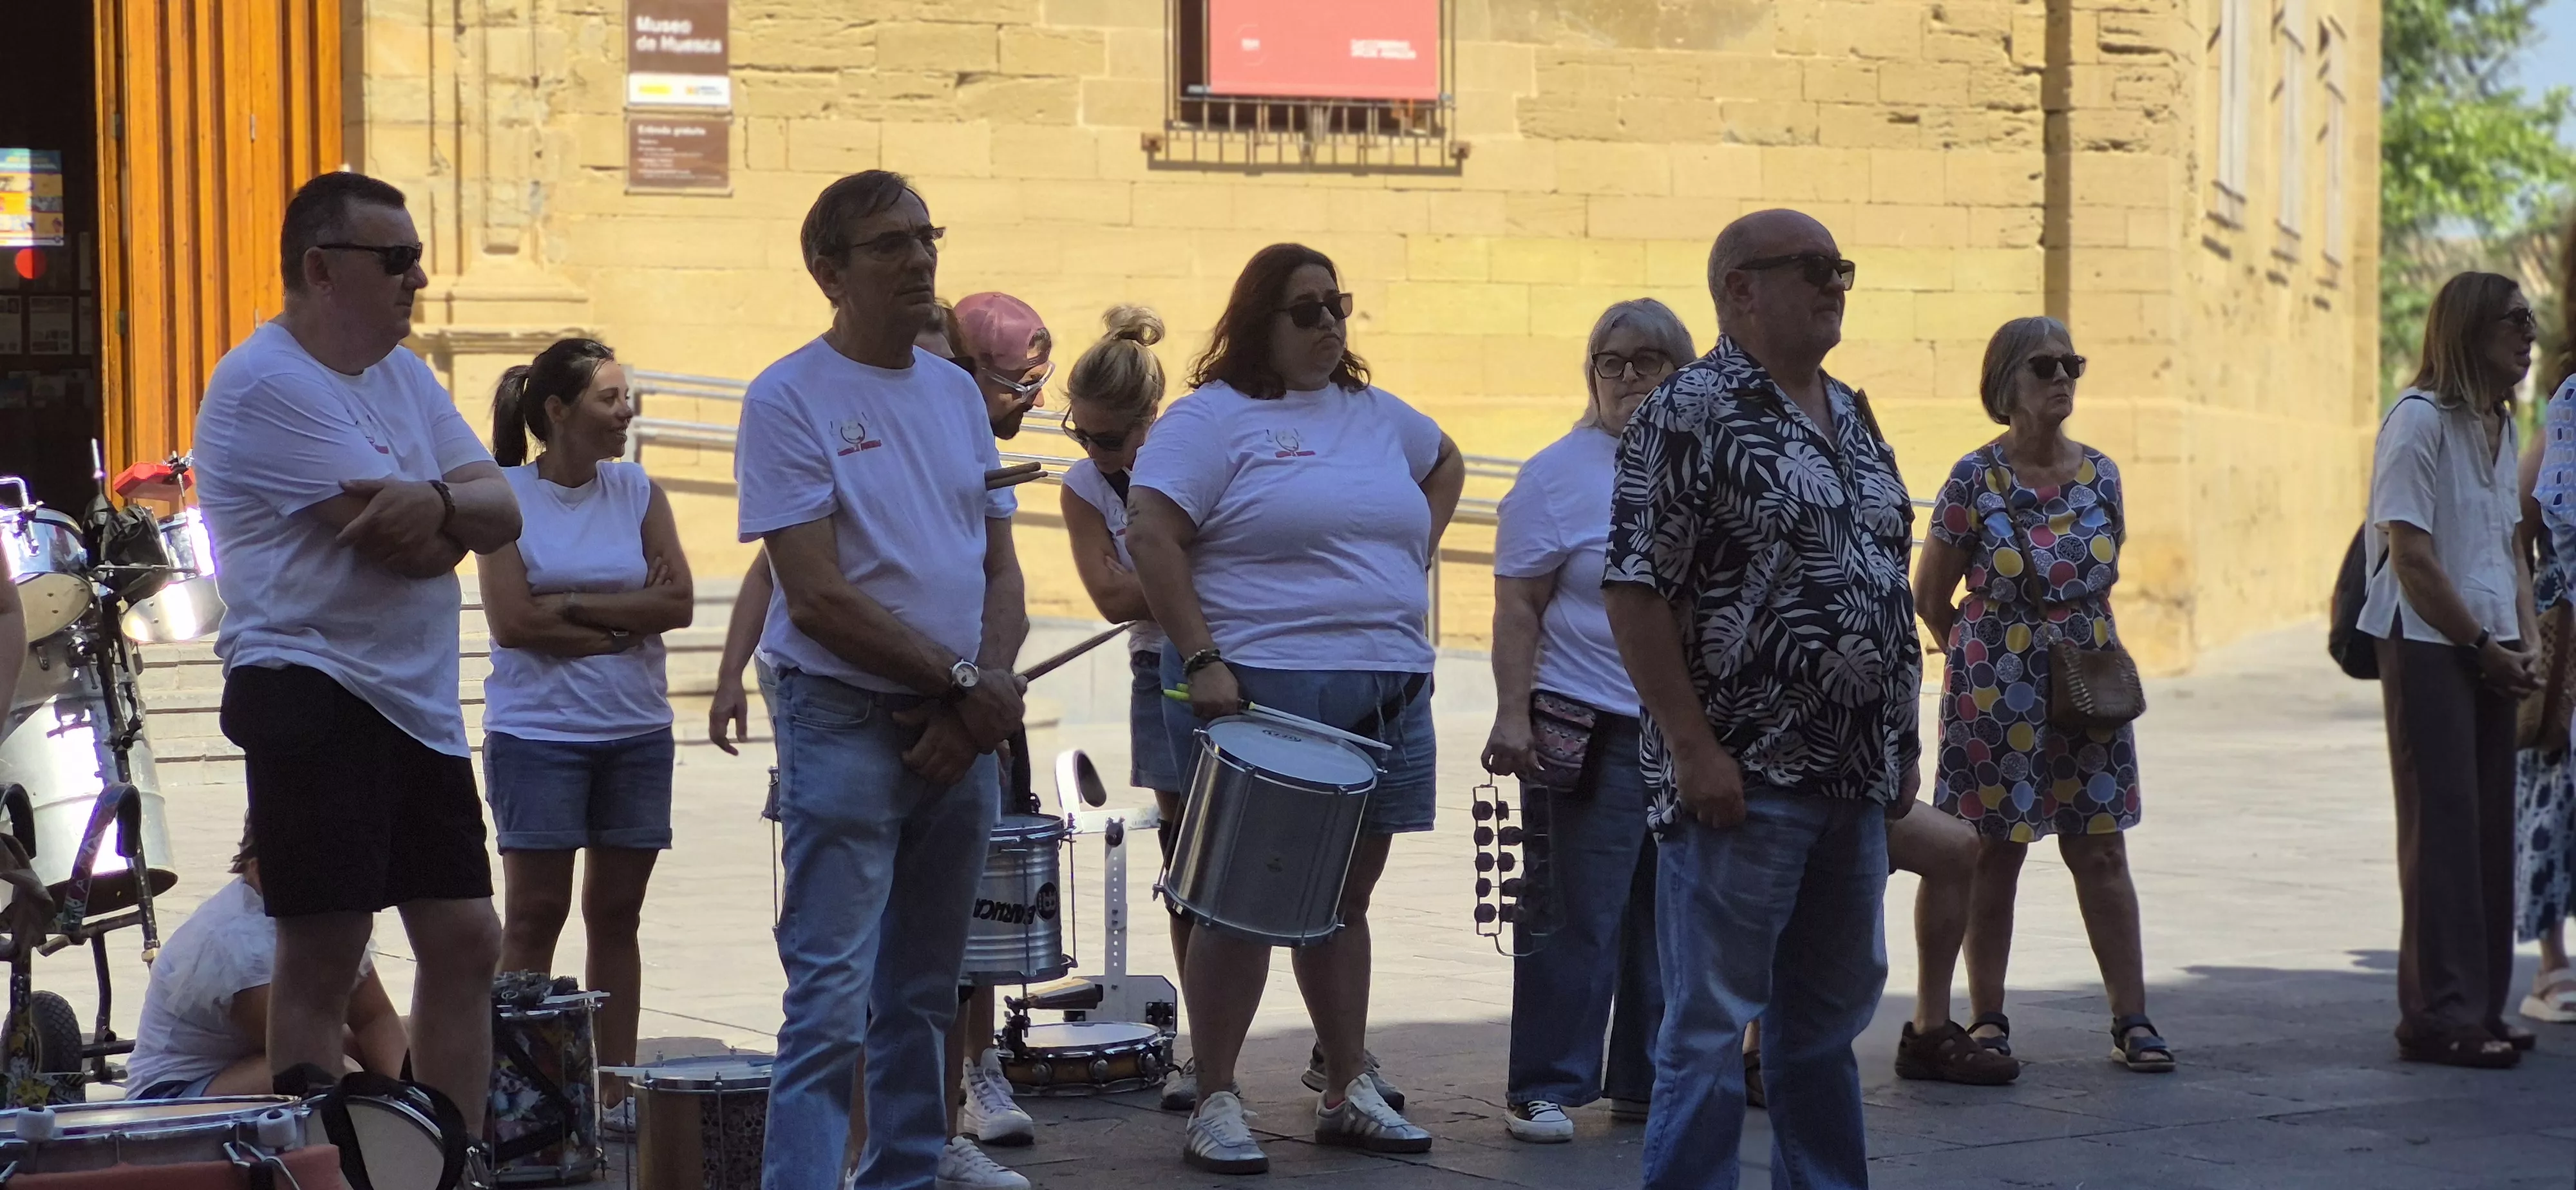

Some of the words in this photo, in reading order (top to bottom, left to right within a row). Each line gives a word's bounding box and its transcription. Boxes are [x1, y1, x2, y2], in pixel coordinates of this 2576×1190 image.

[636, 15, 692, 35] Museo
[636, 35, 657, 52] de
[660, 35, 723, 54] Huesca
